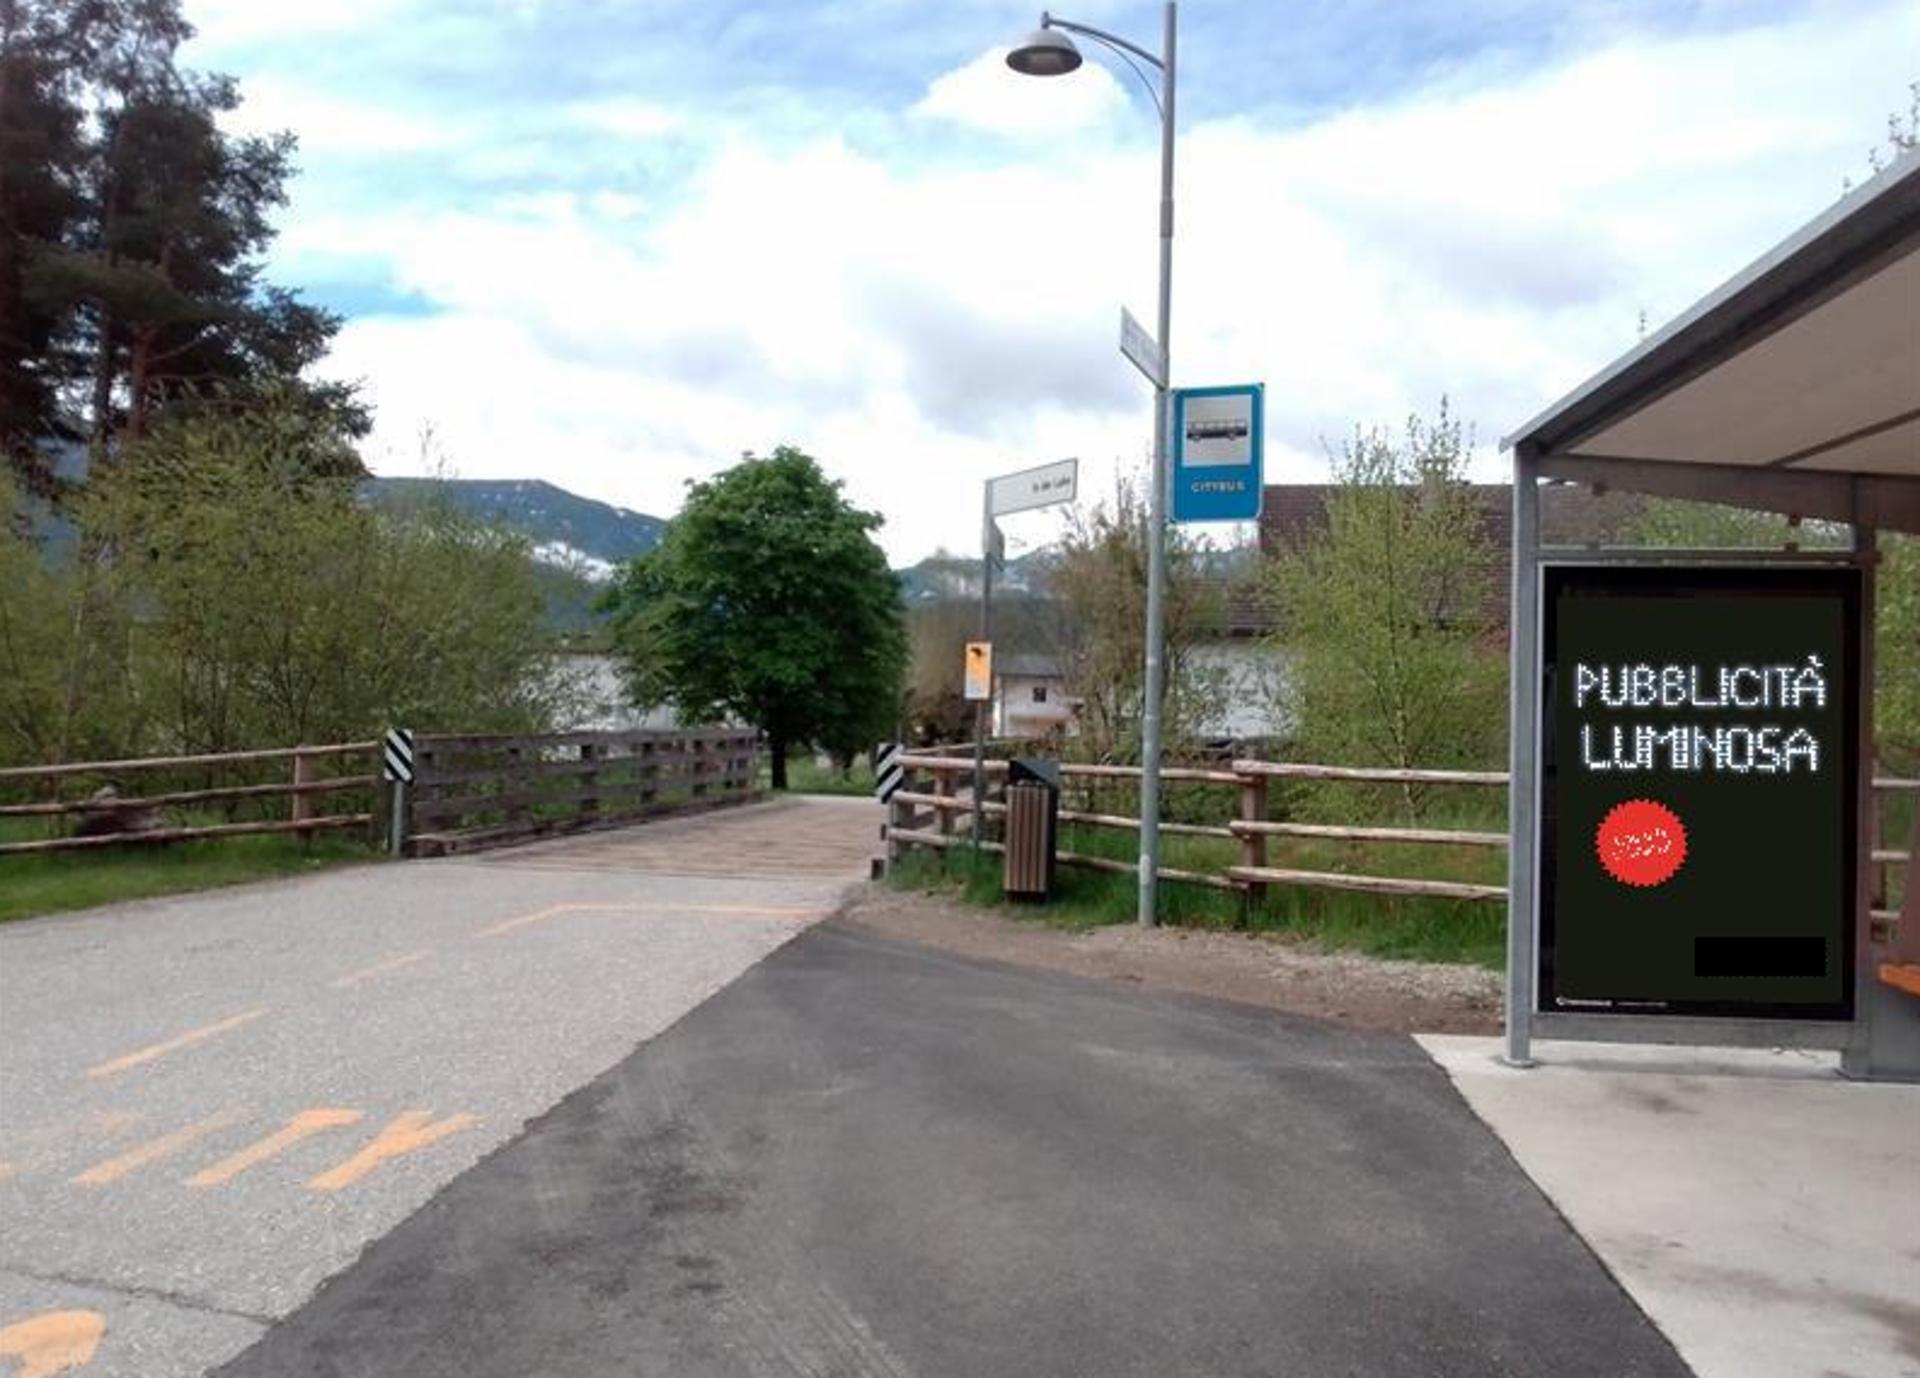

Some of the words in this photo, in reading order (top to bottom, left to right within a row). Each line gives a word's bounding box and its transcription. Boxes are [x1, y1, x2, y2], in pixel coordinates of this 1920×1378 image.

[1190, 480, 1246, 493] CITYBUS
[1577, 653, 1826, 708] PUBBLICITÀ
[1581, 723, 1819, 773] LUMINOSA
